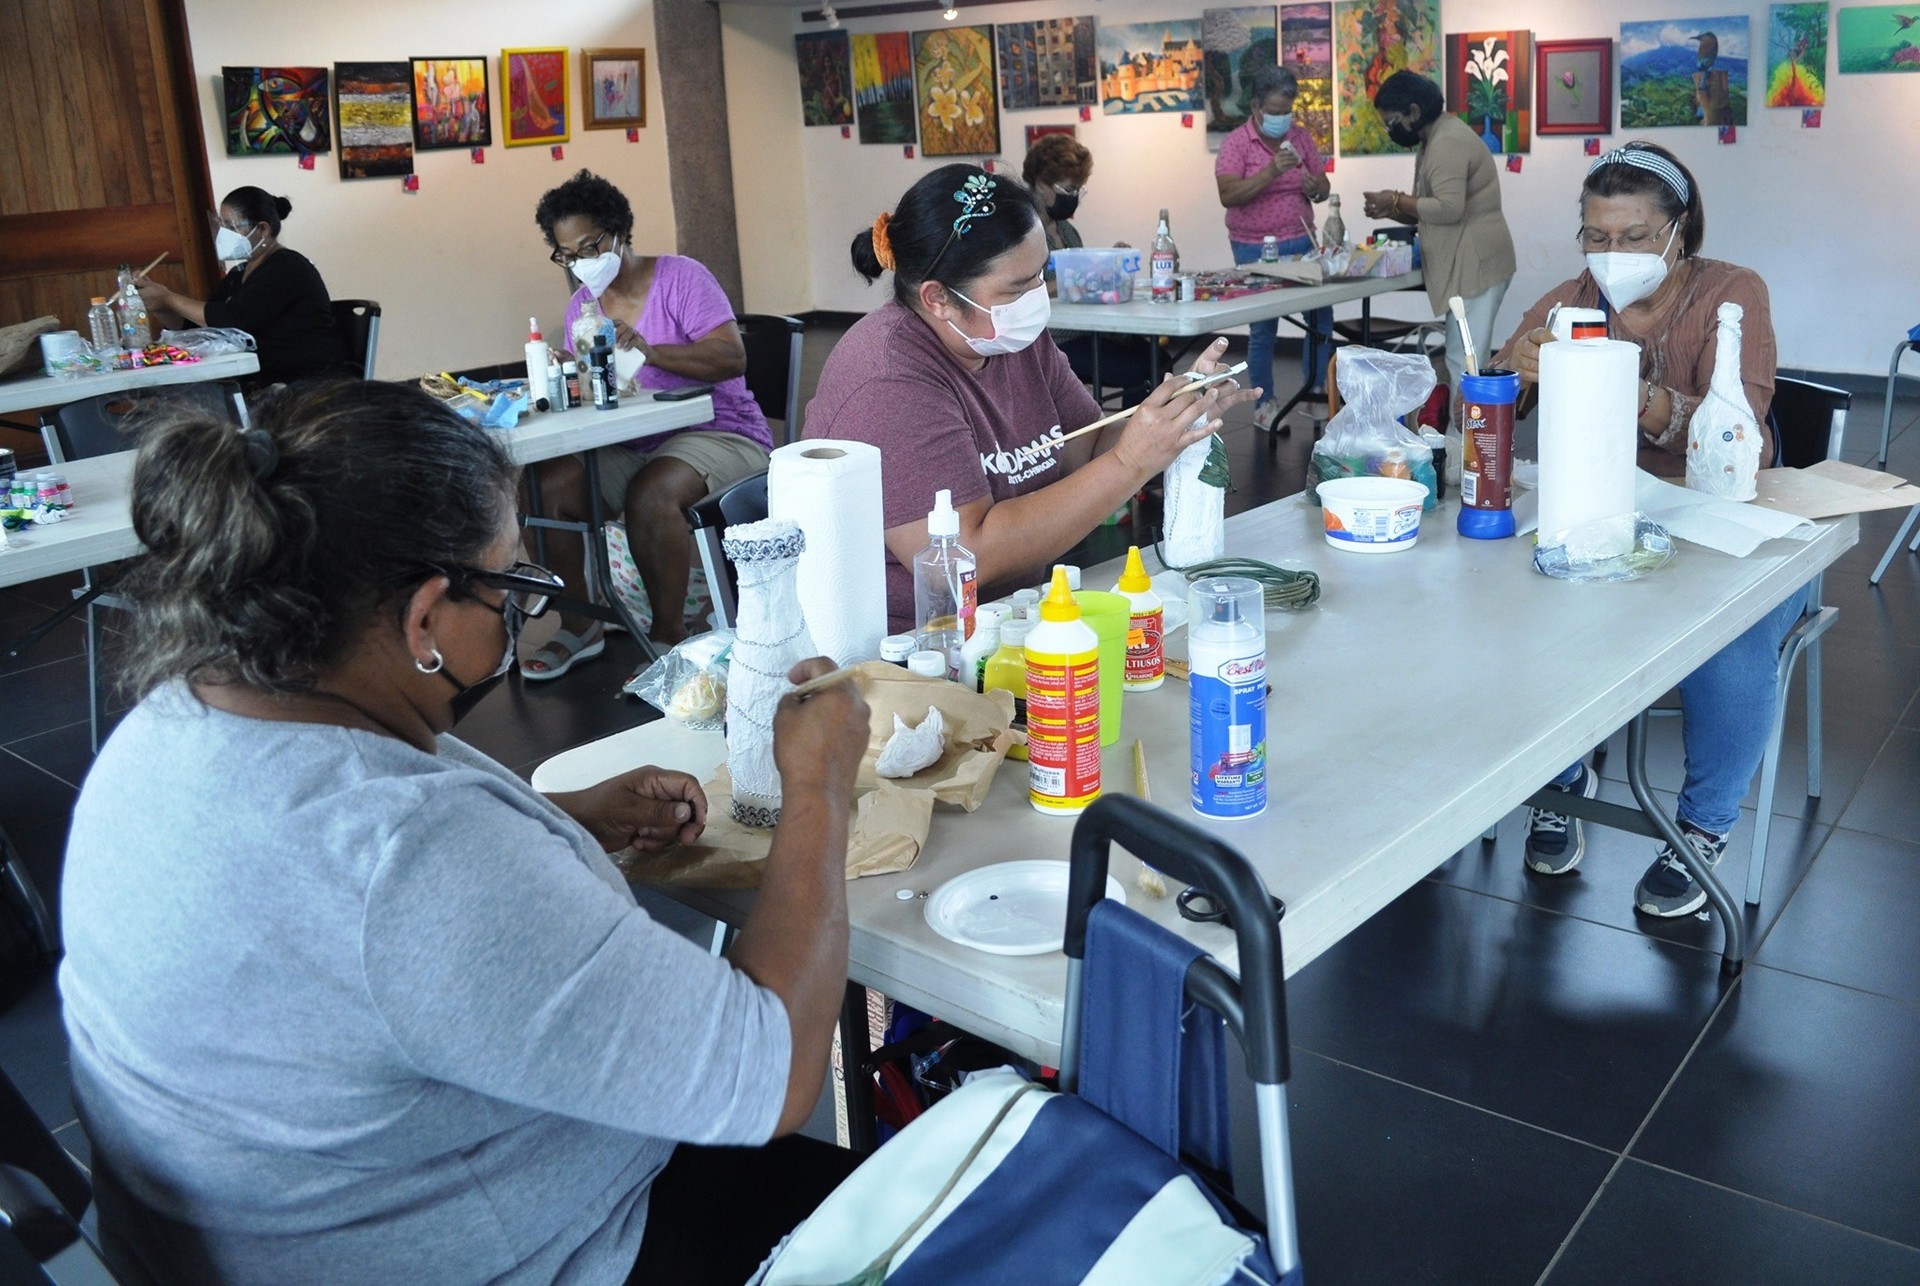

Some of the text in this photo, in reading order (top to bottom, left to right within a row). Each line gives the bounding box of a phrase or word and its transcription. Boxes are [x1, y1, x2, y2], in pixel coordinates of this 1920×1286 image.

[1155, 261, 1172, 270] LUX
[1126, 657, 1161, 669] LTIUSOS
[1233, 685, 1255, 696] SPRAY
